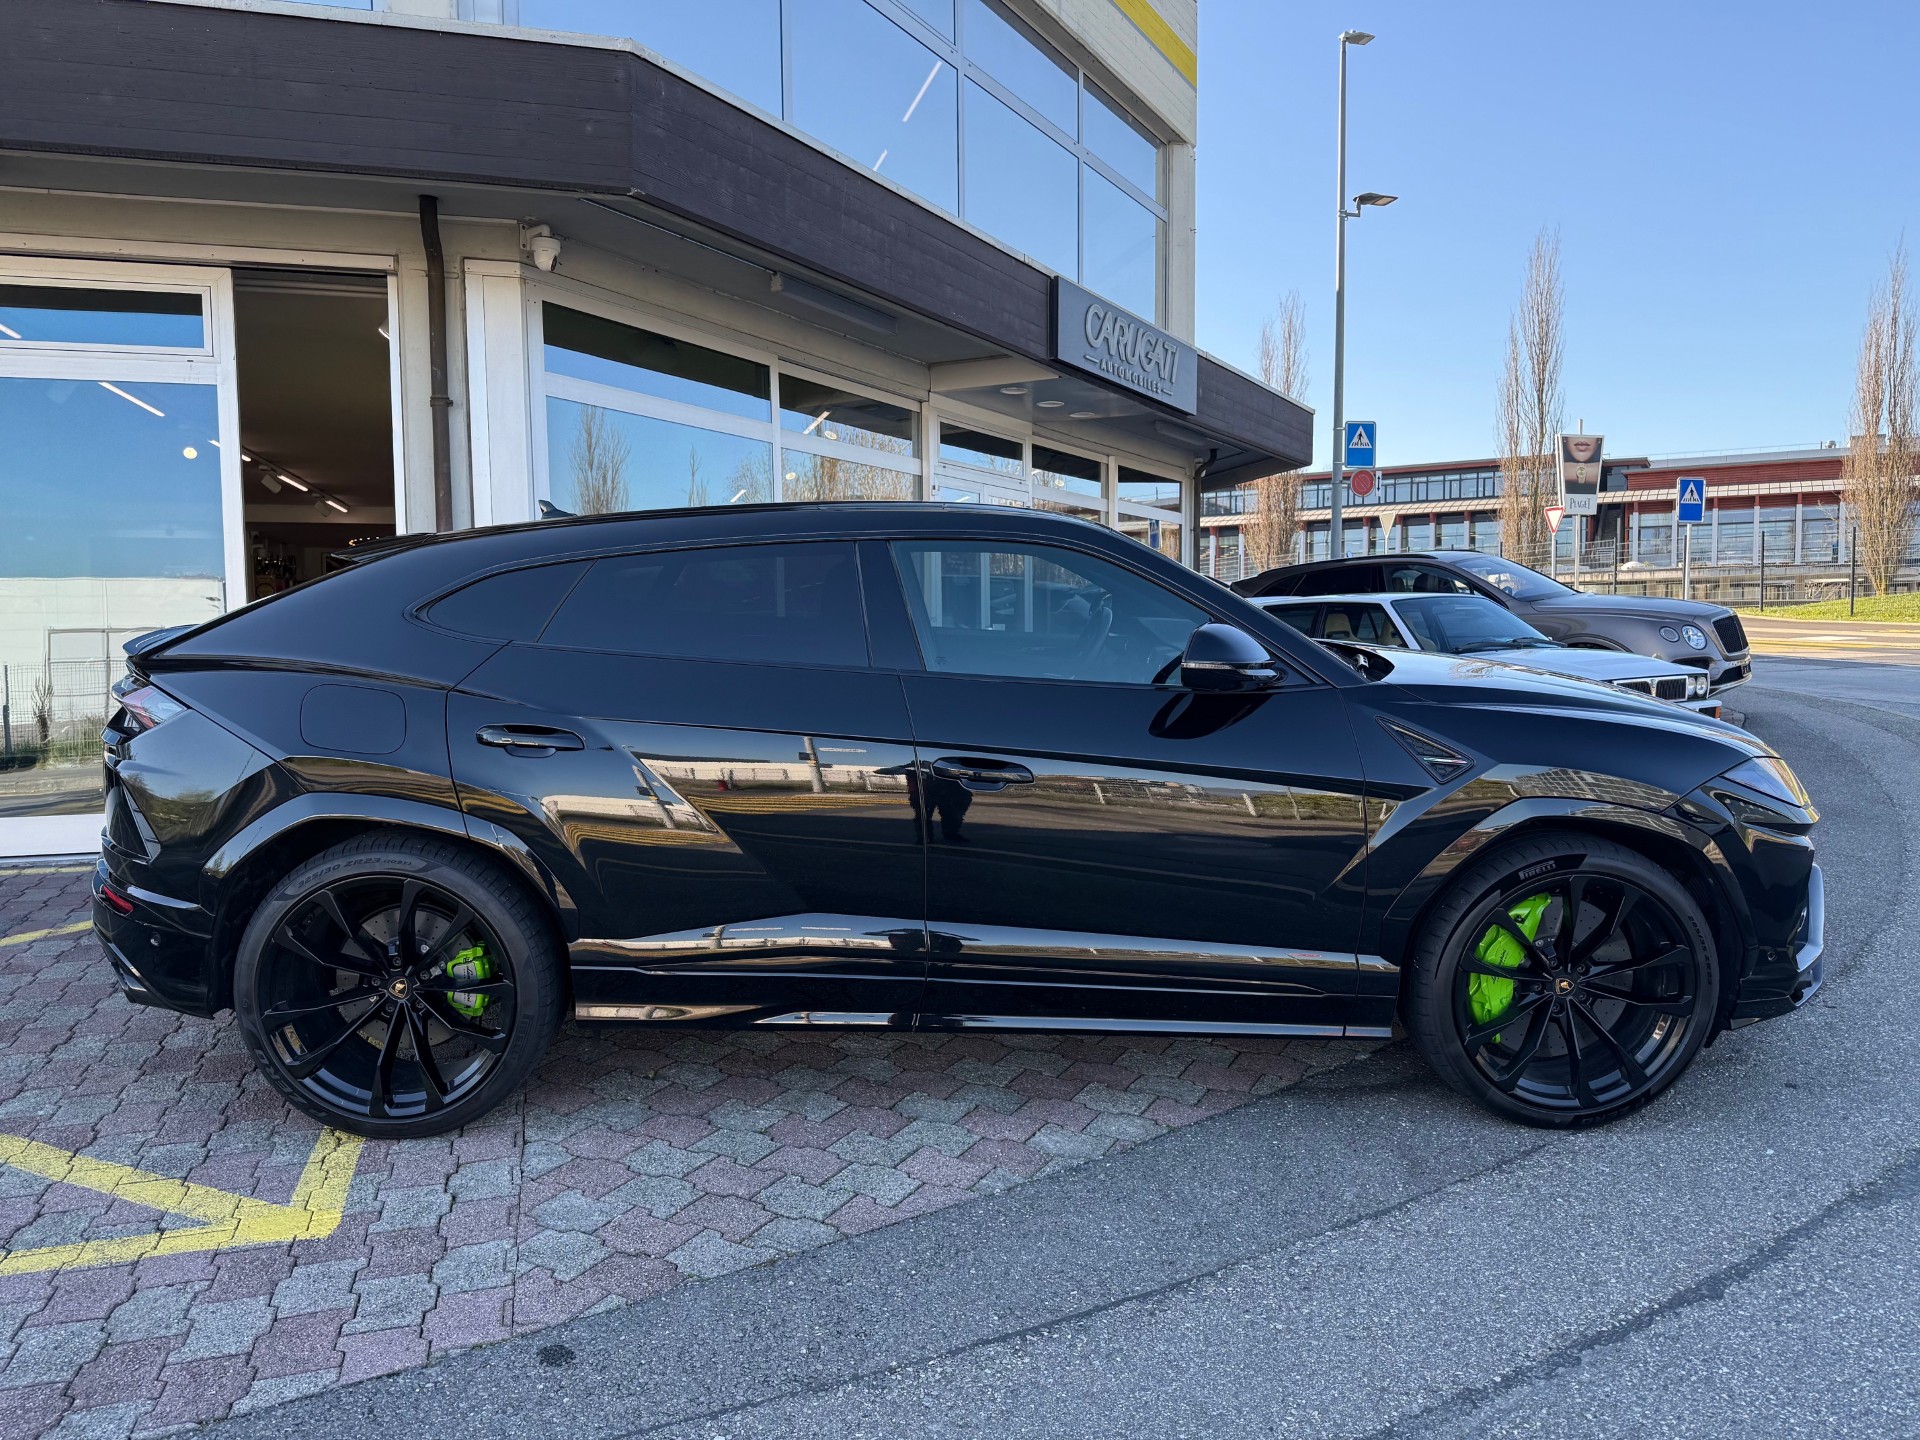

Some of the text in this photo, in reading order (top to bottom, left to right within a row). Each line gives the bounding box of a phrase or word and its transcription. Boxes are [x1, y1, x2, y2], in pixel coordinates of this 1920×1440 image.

[1084, 303, 1179, 384] CARUGATI
[1100, 357, 1162, 394] AUTOMOBILES
[1569, 497, 1591, 509] PIAGET
[298, 863, 341, 889] 325/30
[343, 857, 381, 868] ZR23
[1518, 859, 1557, 881] PIRELLI
